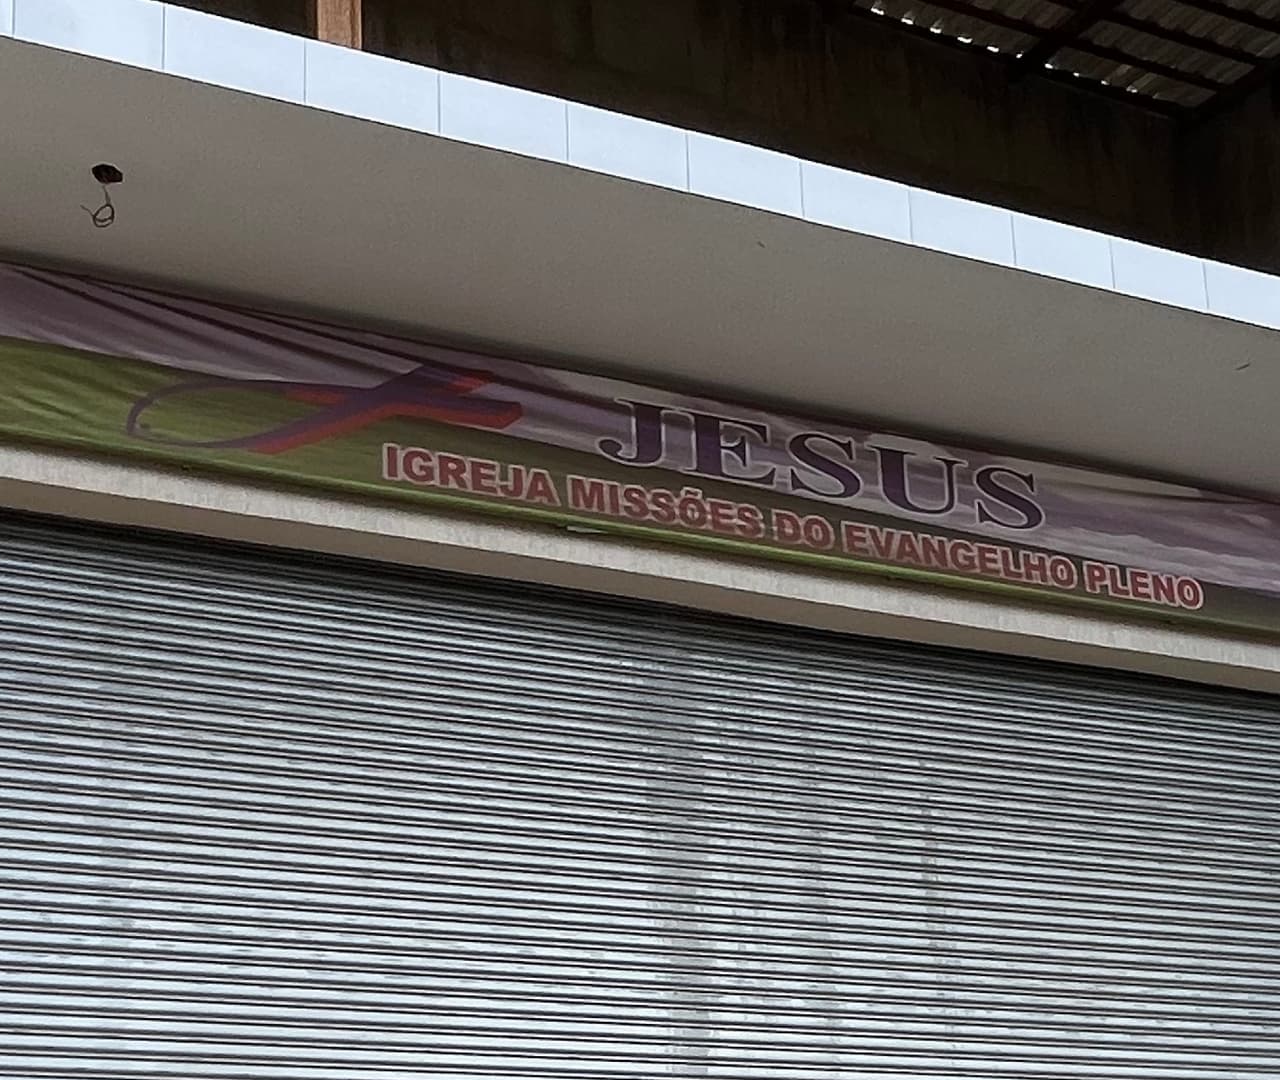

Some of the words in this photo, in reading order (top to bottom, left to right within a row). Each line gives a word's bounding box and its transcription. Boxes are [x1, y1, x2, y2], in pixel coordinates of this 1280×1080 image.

[384, 443, 560, 506] IGREJA
[567, 475, 764, 539] MISSÕES
[772, 508, 835, 550] DO
[841, 520, 1076, 590] EVANGELHO
[1083, 562, 1204, 611] PLENO
[598, 398, 1044, 531] JESUS
